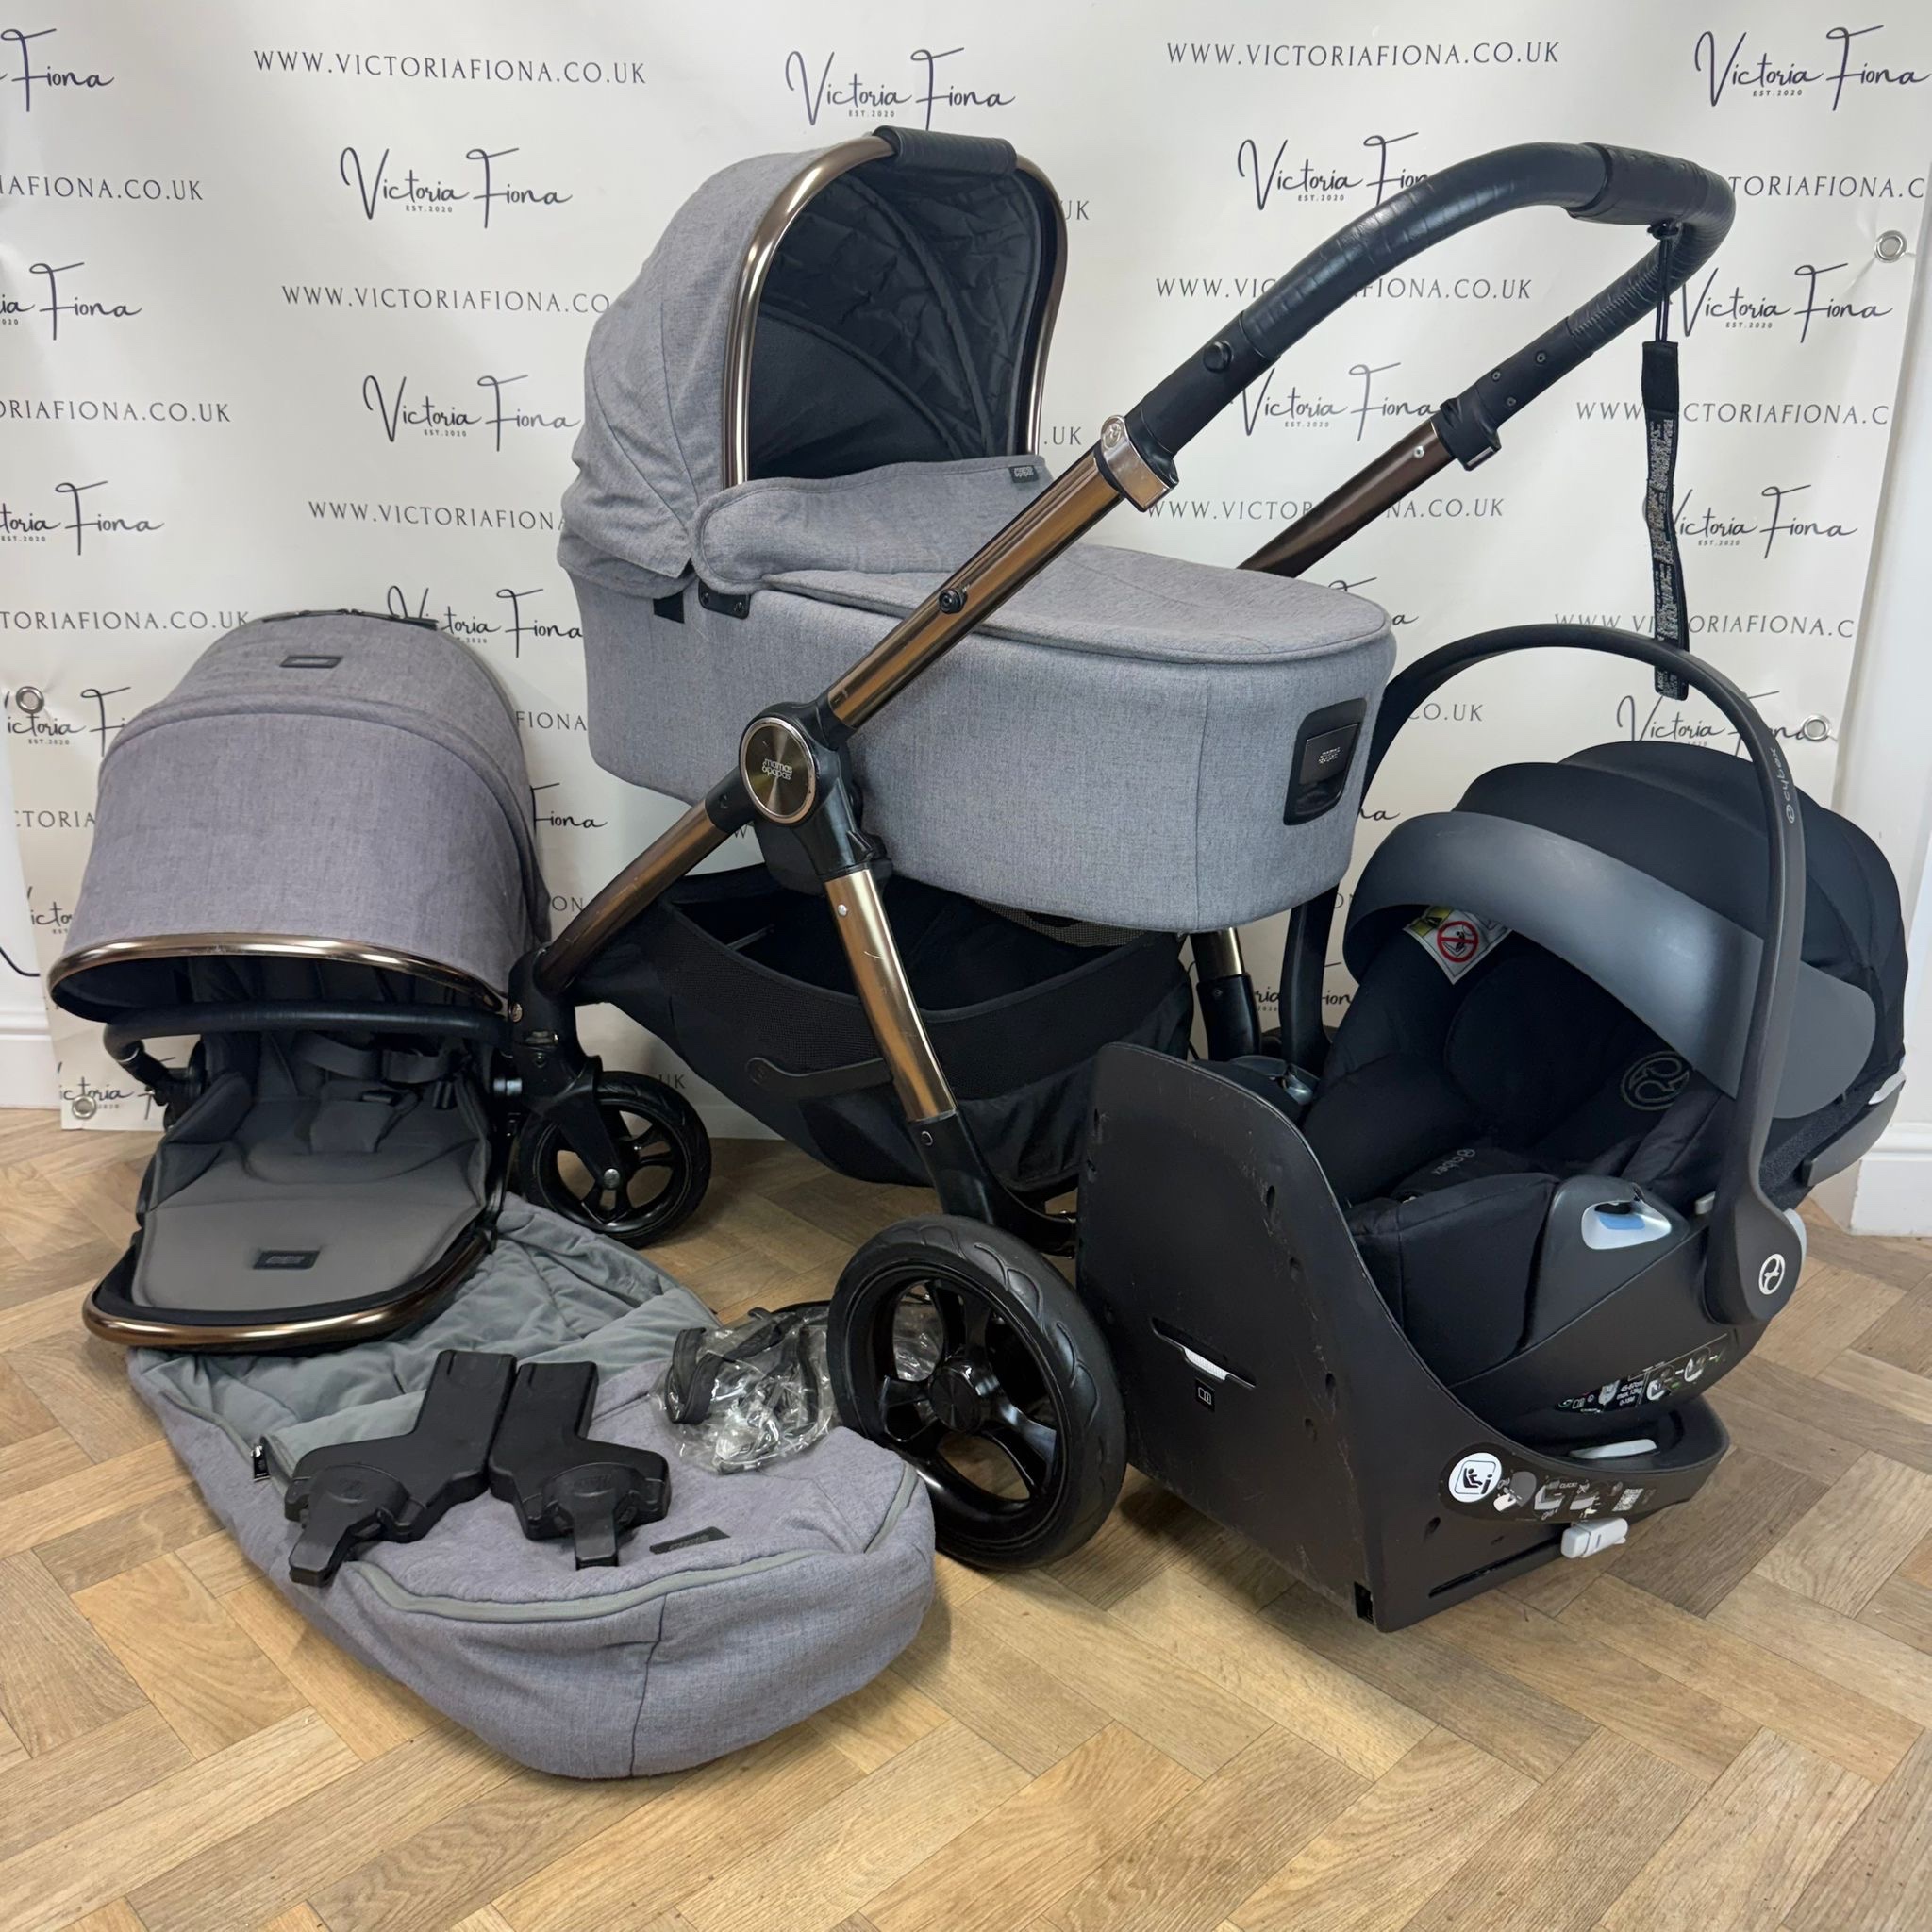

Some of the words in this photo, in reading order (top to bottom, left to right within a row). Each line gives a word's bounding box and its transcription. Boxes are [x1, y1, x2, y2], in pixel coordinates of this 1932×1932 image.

[1, 29, 114, 111] Fiona
[253, 50, 646, 84] WWW.VICTORIAFIONA.CO.UK
[786, 51, 911, 125] Victoria
[911, 48, 1015, 129] Fiona
[1166, 42, 1559, 66] WWW.VICTORIAFIONA.CO.UK
[1695, 31, 1822, 107] Victoria
[1826, 25, 1932, 110] Fiona
[849, 109, 895, 118] EST.2020
[341, 147, 469, 219] Victoria
[466, 148, 573, 228] Fiona
[1237, 139, 1364, 209] Victoria
[1364, 132, 1427, 205] Fion
[406, 205, 453, 213] EST.2020
[29, 262, 142, 340] Fiona
[1794, 263, 1892, 342] Fiona
[363, 375, 481, 442] Victoria
[477, 375, 582, 451] Fiona
[1241, 369, 1348, 437] Victoria
[1349, 362, 1441, 441] Fiona
[56, 481, 164, 555] Fiona
[1757, 485, 1857, 558] Fiona
[497, 589, 583, 658] Fiona
[764, 758, 793, 774] mamas
